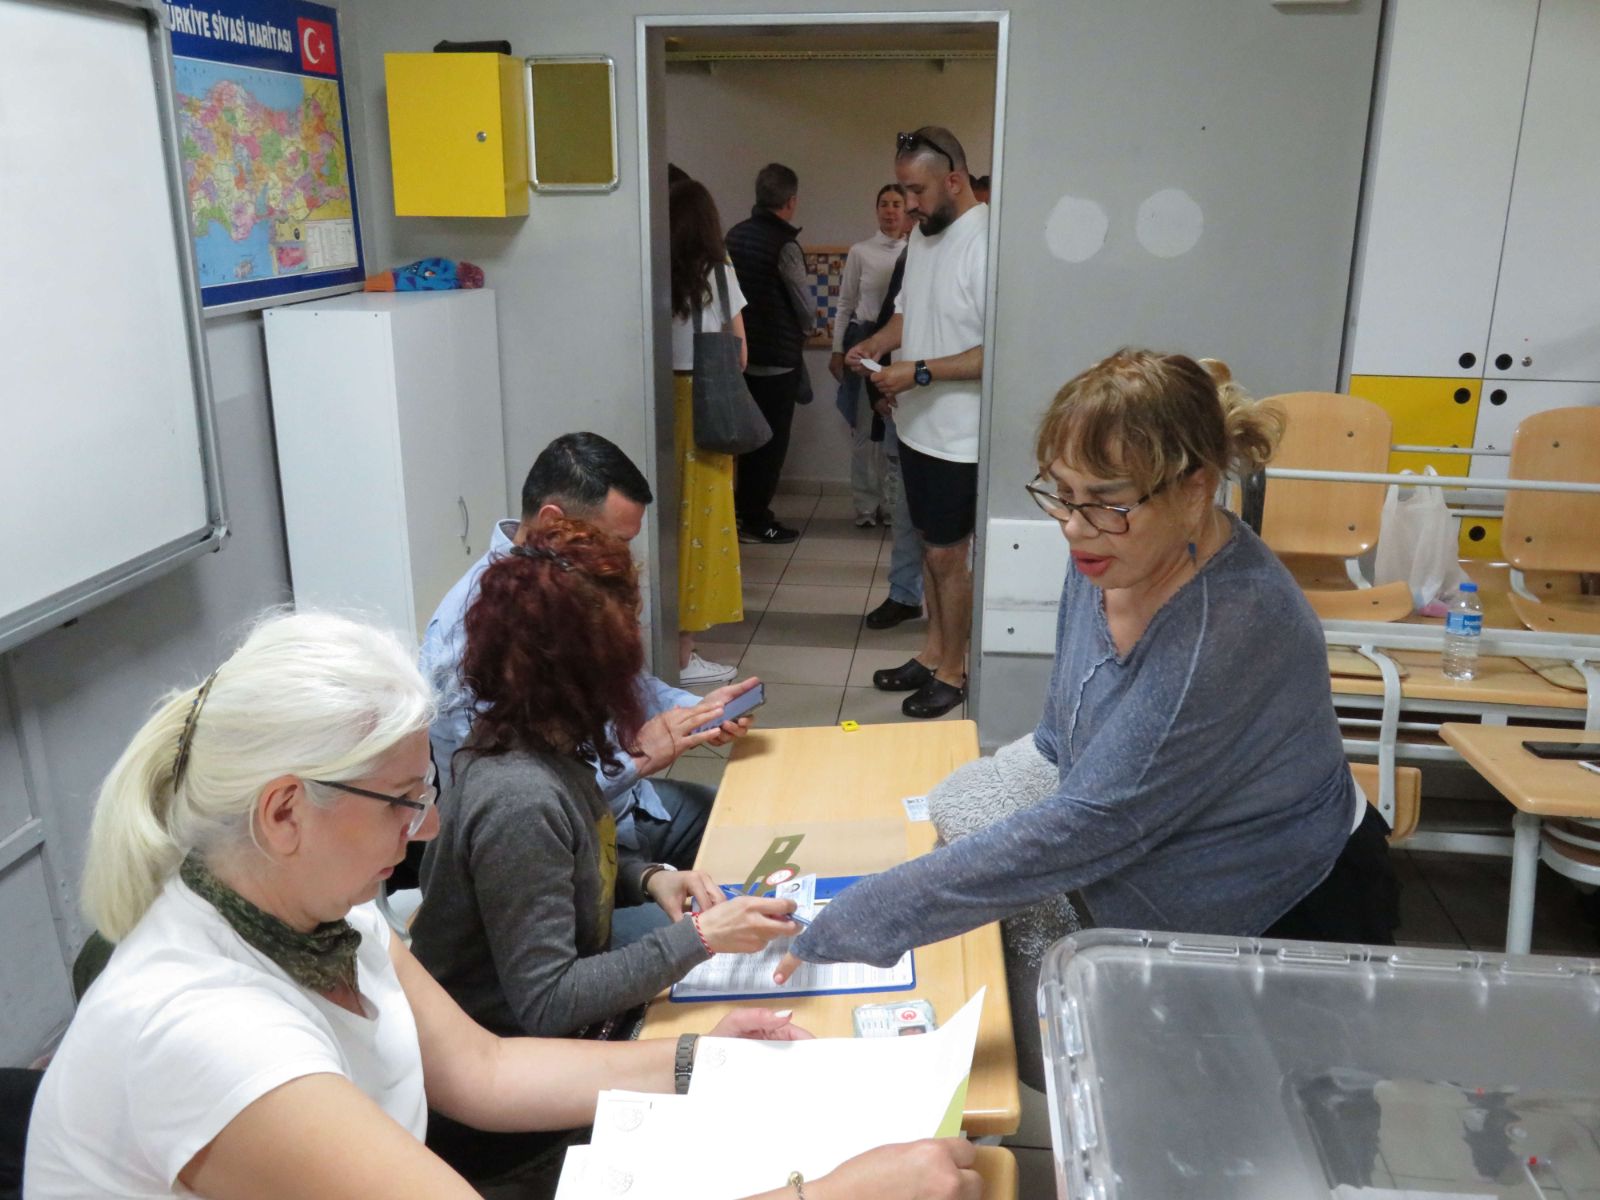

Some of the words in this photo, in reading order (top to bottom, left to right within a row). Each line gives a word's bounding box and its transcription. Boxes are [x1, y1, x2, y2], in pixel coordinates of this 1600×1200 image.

[166, 0, 211, 38] ÜRKİYE
[212, 10, 248, 45] SİYASİ
[249, 21, 293, 53] HARİTASI
